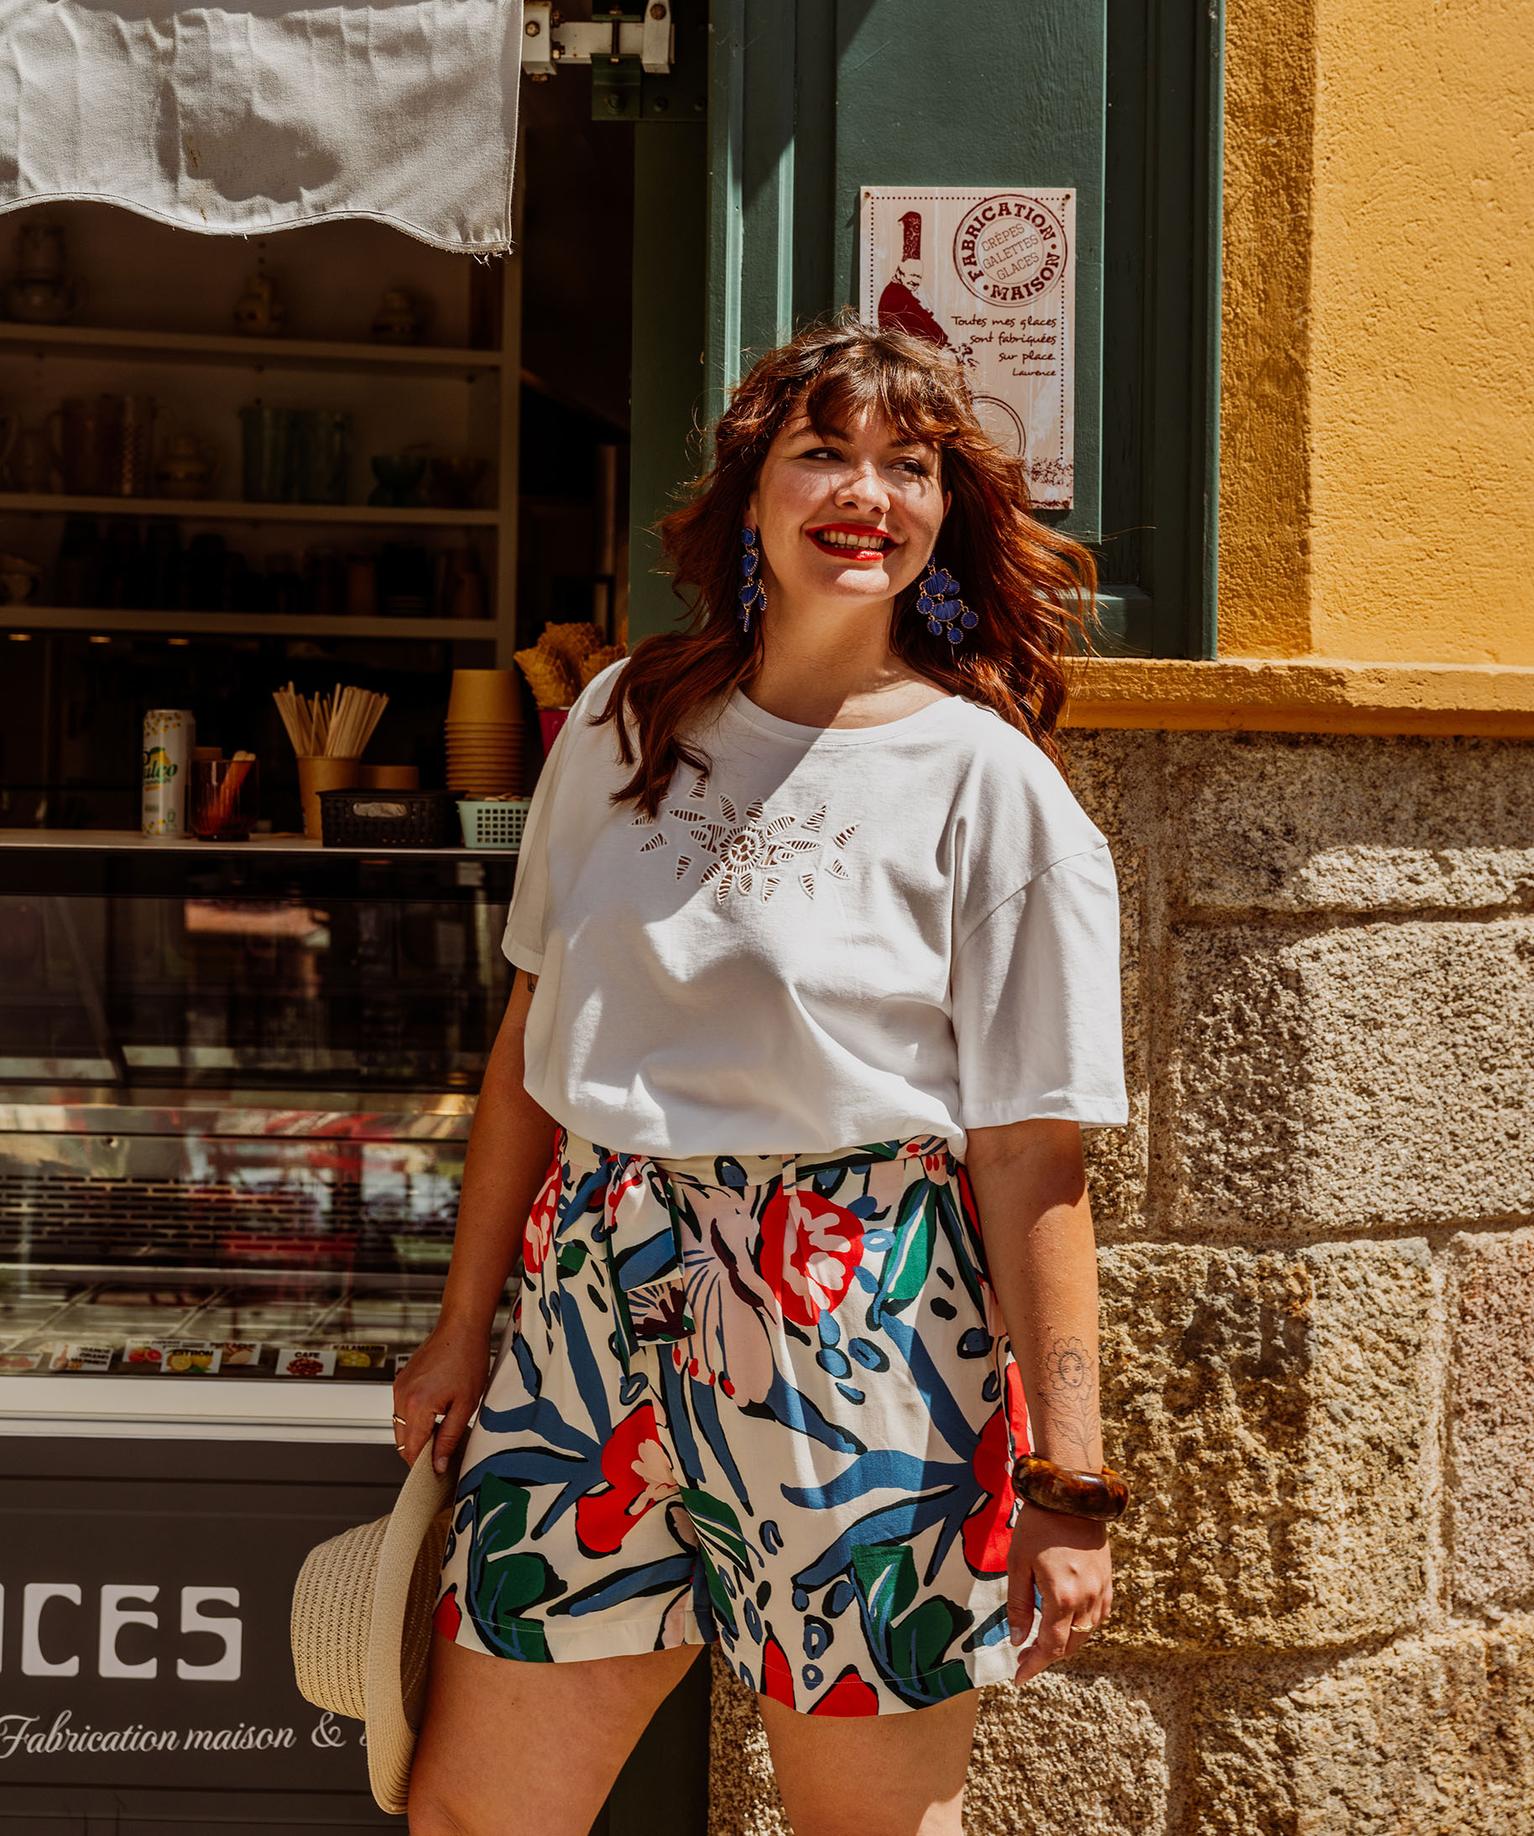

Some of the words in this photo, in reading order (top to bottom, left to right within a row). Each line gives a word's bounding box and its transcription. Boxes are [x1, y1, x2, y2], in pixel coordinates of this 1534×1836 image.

[961, 202, 1056, 282] FABRICATION
[982, 234, 1039, 269] GALETTES
[990, 252, 1060, 301] MAISON
[996, 252, 1040, 280] GLACES
[951, 314, 987, 327] Toutes
[992, 317, 1015, 328] mes
[1020, 315, 1057, 330] glaces
[970, 331, 993, 344] sont
[998, 331, 1057, 346] fabriquées
[998, 352, 1018, 362] sur
[1022, 350, 1055, 364] place
[1012, 368, 1056, 376] Laurence
[0, 1583, 242, 1681] CES
[0, 1709, 180, 1759] Fabrication
[183, 1722, 297, 1751] maison
[311, 1711, 347, 1748] &
